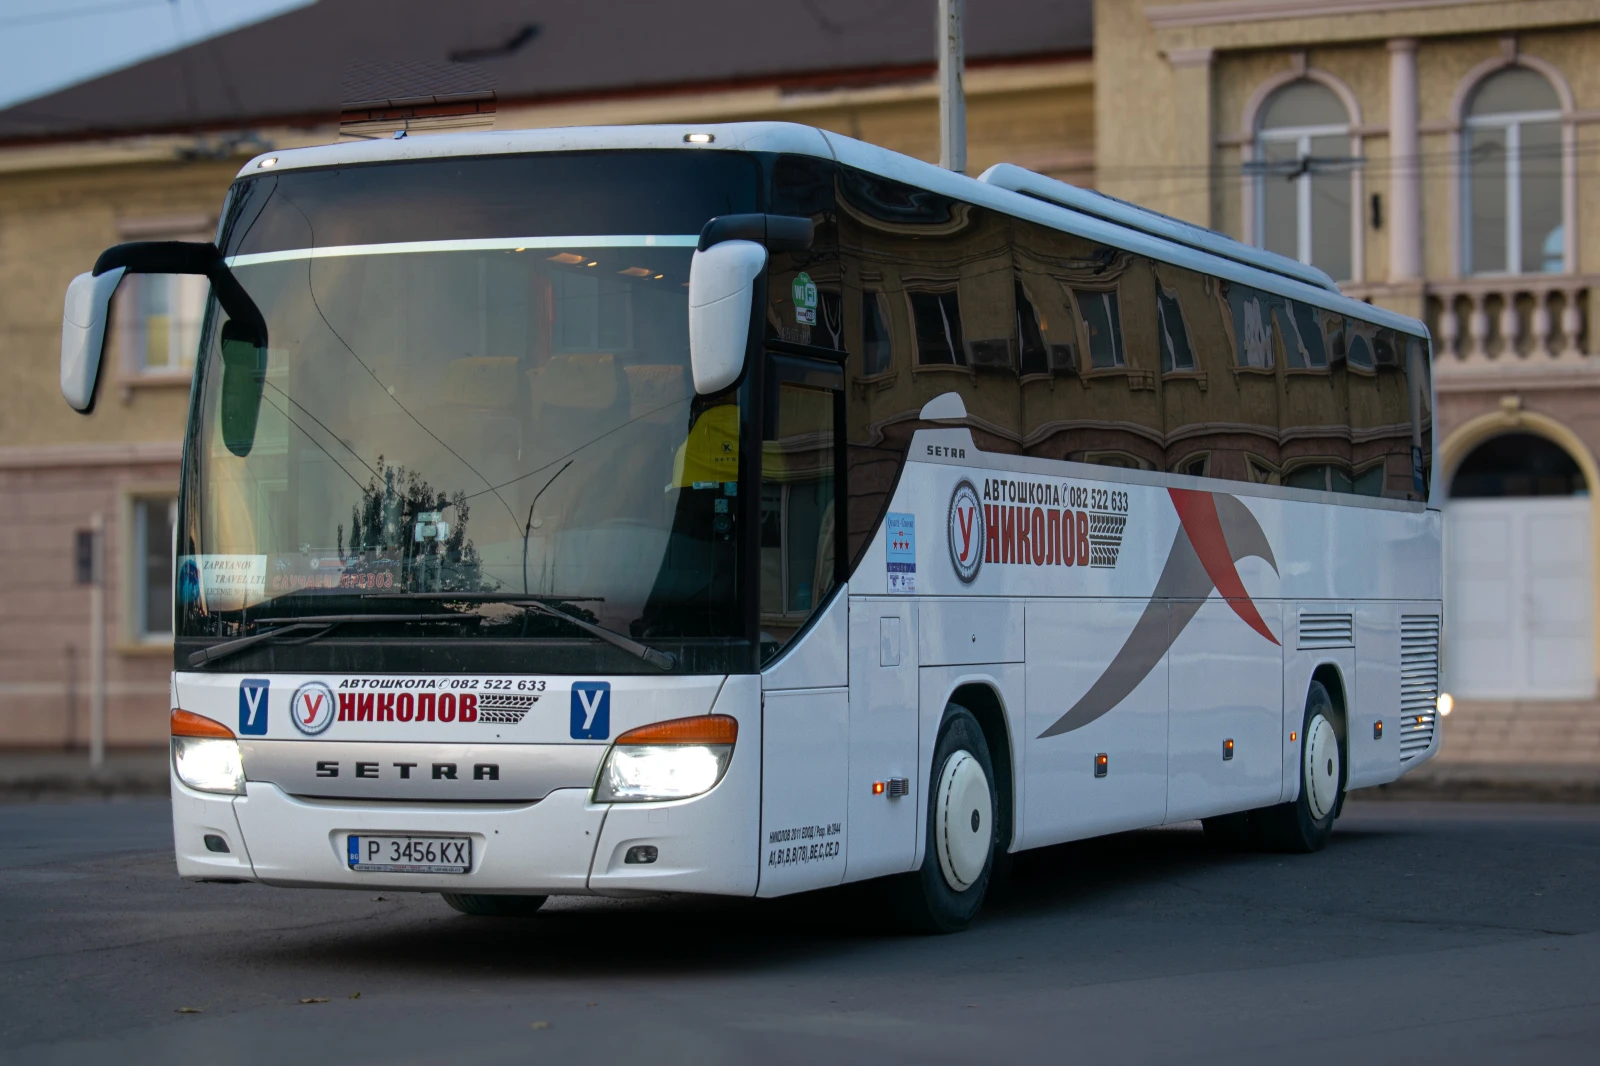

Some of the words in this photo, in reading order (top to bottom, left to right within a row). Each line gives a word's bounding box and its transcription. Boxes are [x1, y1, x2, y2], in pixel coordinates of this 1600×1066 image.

[927, 445, 966, 458] SETRA
[984, 478, 1060, 506] АВТОШКОЛА
[1070, 486, 1088, 508] 082
[1091, 488, 1108, 510] 522
[1112, 490, 1128, 512] 633
[984, 504, 1090, 567] НИКОЛОВ
[204, 560, 254, 570] ZAPRYANOV
[216, 574, 248, 584] TRAVEL
[338, 679, 437, 690] АВТОШКОЛА
[450, 679, 480, 690] 082
[483, 680, 513, 691] 522
[517, 680, 547, 692] 633
[243, 686, 265, 726] У
[338, 693, 478, 723] НИКОЛОВ
[577, 689, 604, 730] У
[316, 760, 500, 781] SETRA
[368, 840, 380, 861] P
[390, 841, 436, 862] 3456
